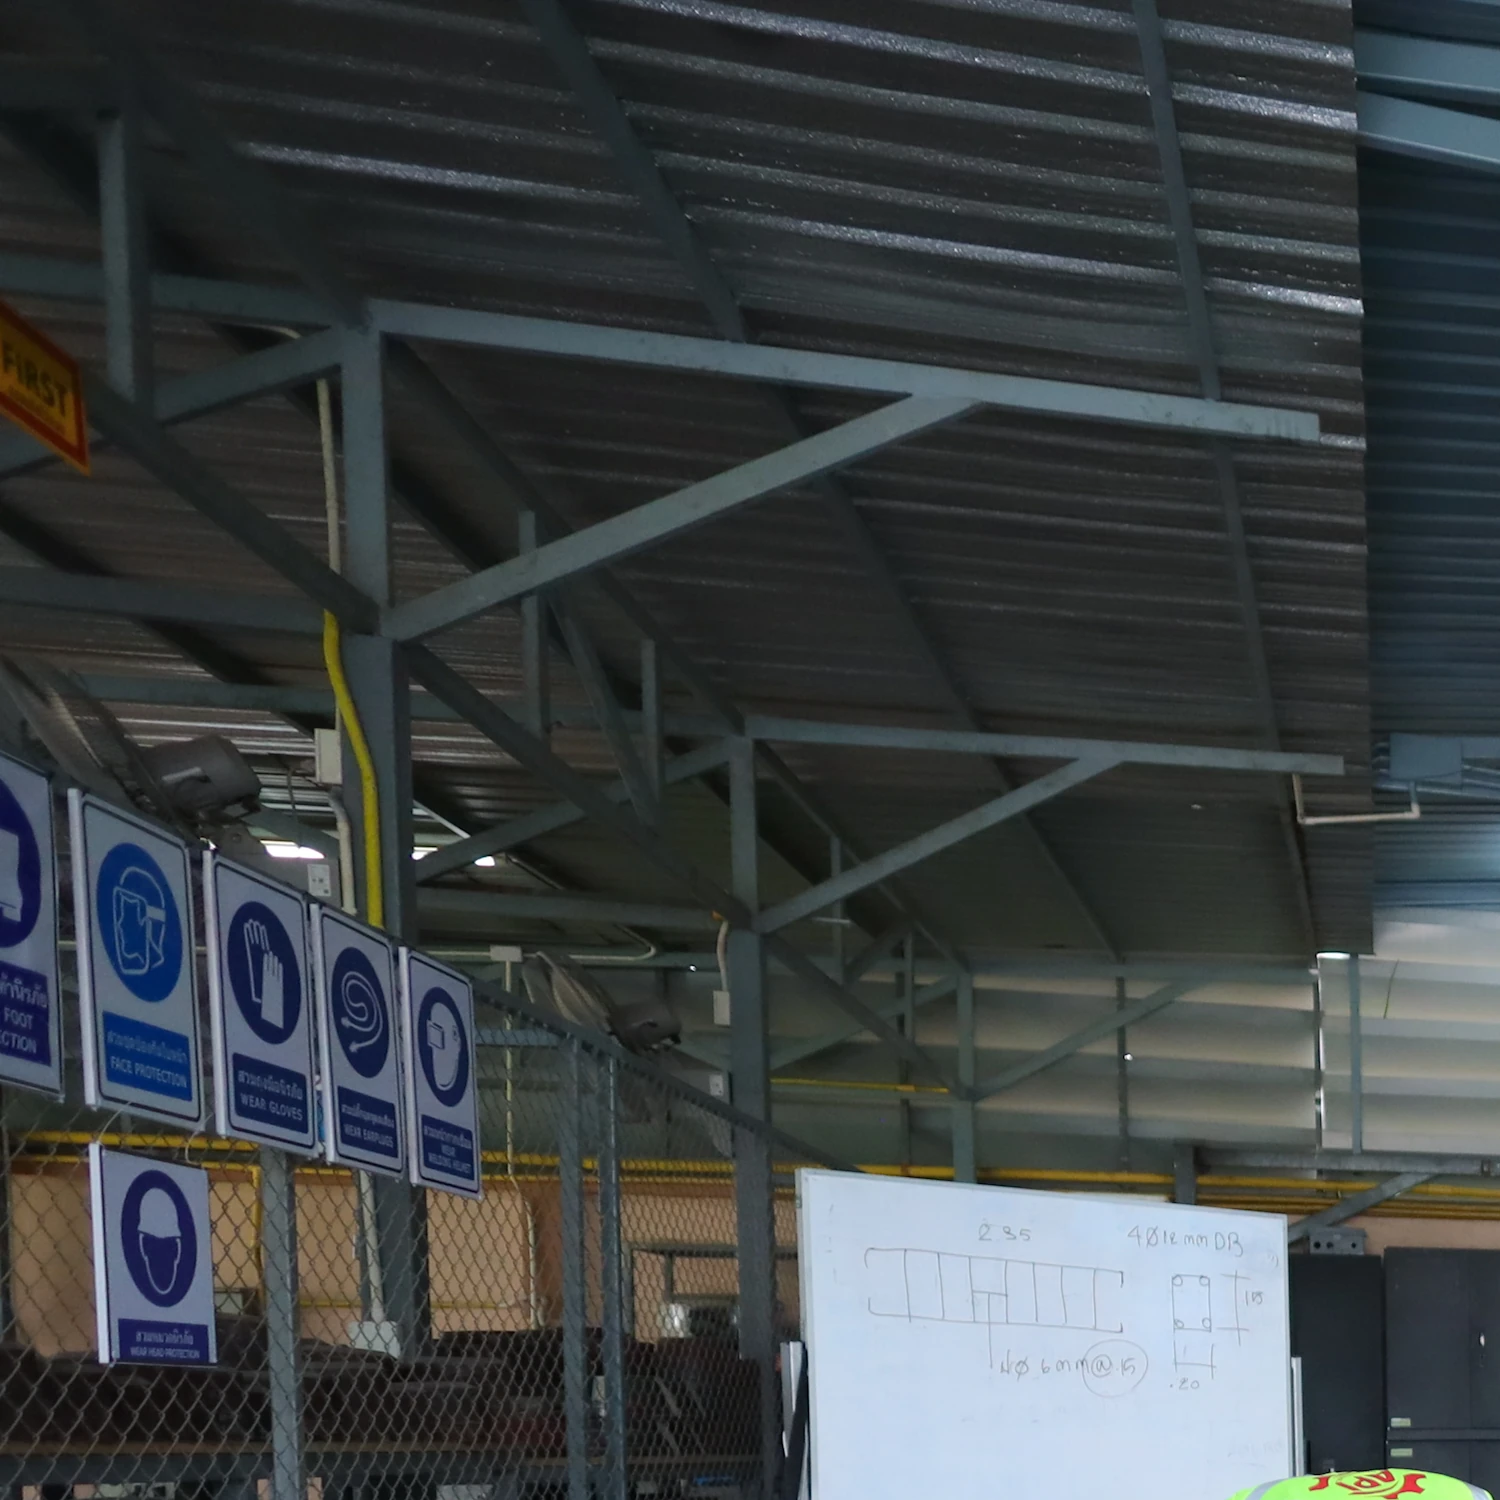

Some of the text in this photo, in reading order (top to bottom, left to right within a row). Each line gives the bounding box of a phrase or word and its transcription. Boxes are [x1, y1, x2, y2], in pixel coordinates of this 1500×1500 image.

[4, 1007, 33, 1030] FOOT
[0, 1029, 37, 1054] CTION
[110, 1055, 187, 1089] FACE PROTECTION
[240, 1092, 304, 1121] WEAR GLOVES
[343, 1123, 394, 1149] WEAR EARPLUGS
